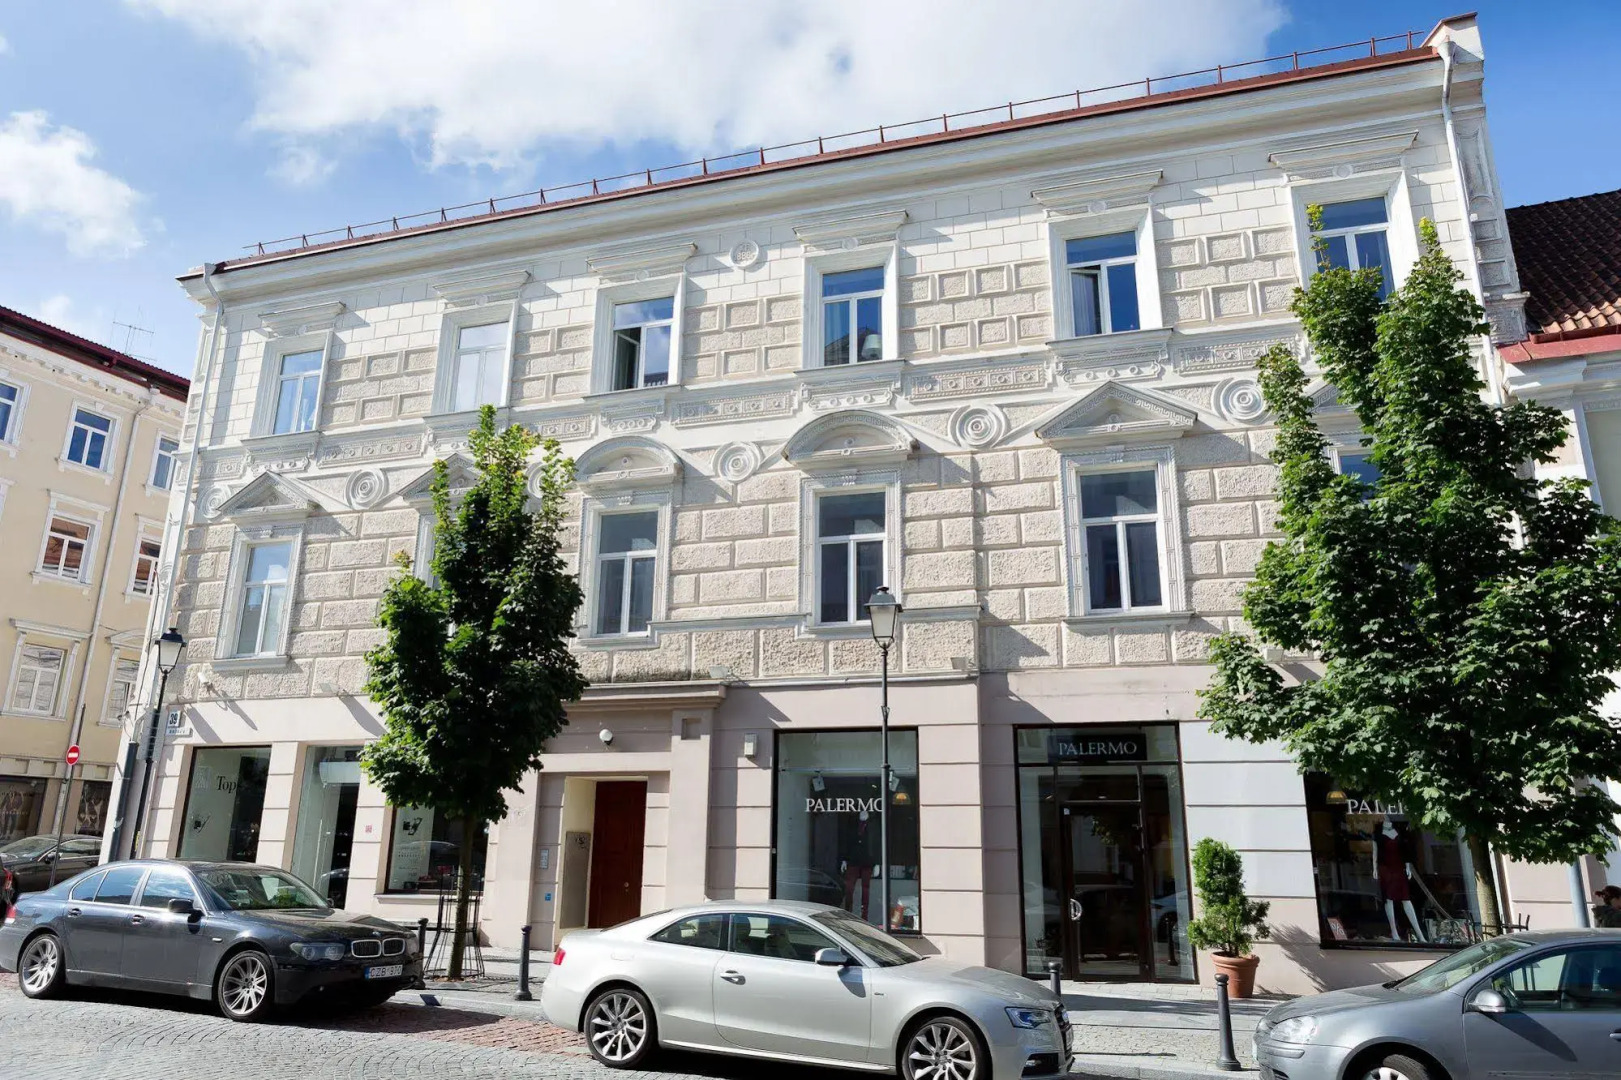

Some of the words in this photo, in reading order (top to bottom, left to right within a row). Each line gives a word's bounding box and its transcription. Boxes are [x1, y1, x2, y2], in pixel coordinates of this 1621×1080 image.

[169, 713, 178, 725] 39
[1058, 741, 1137, 755] PALERMO
[216, 775, 237, 794] Top
[370, 967, 387, 978] CZB
